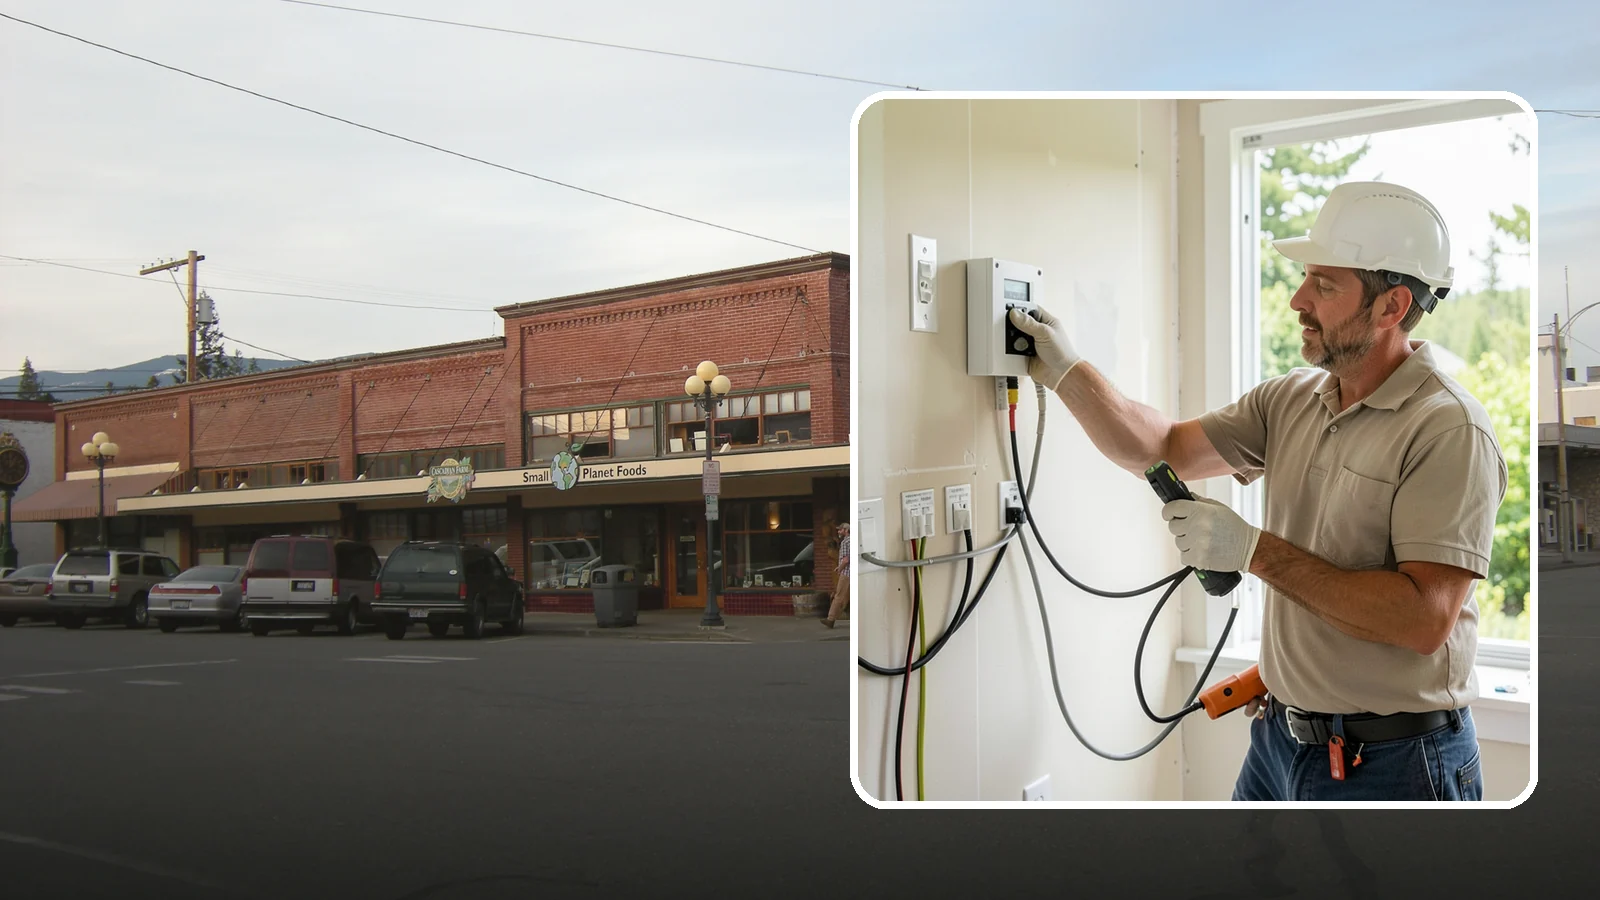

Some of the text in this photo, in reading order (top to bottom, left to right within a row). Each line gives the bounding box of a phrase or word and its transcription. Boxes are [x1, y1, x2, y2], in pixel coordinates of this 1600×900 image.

[523, 464, 647, 483] Small Planet Foods
